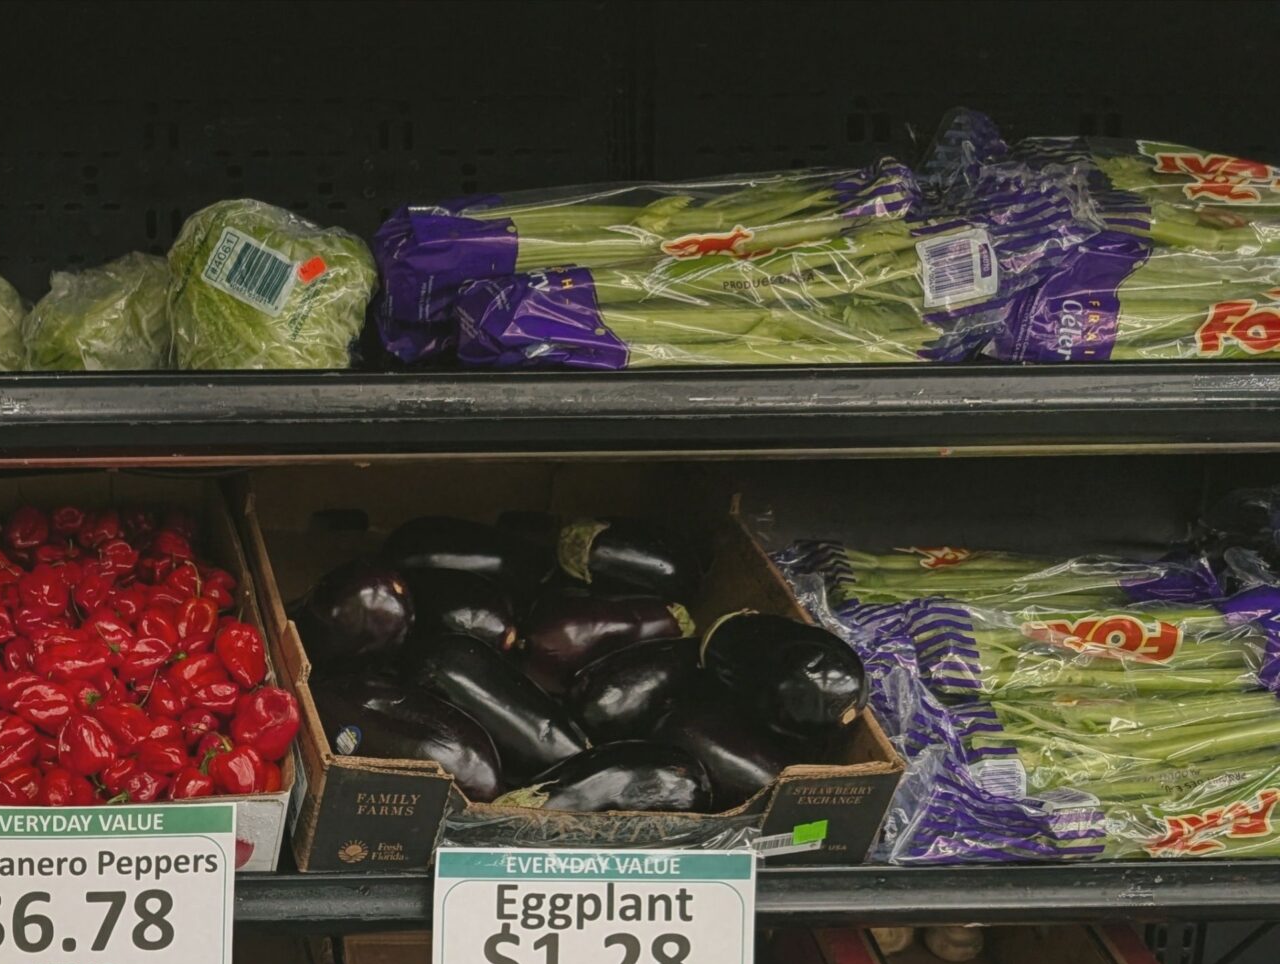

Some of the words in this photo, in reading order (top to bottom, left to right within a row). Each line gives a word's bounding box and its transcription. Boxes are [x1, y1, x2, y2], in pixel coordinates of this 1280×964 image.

[210, 233, 235, 278] #4061
[357, 793, 421, 804] FAMILY
[792, 786, 875, 796] STRAWBERRY
[797, 796, 863, 805] EXCHANGE
[357, 805, 415, 816] FARMS
[99, 812, 165, 831] VALUE
[98, 850, 218, 880] Peppers
[506, 857, 611, 875] EVERYDAY
[616, 857, 681, 875] VALUE
[495, 882, 693, 930] Eggplant
